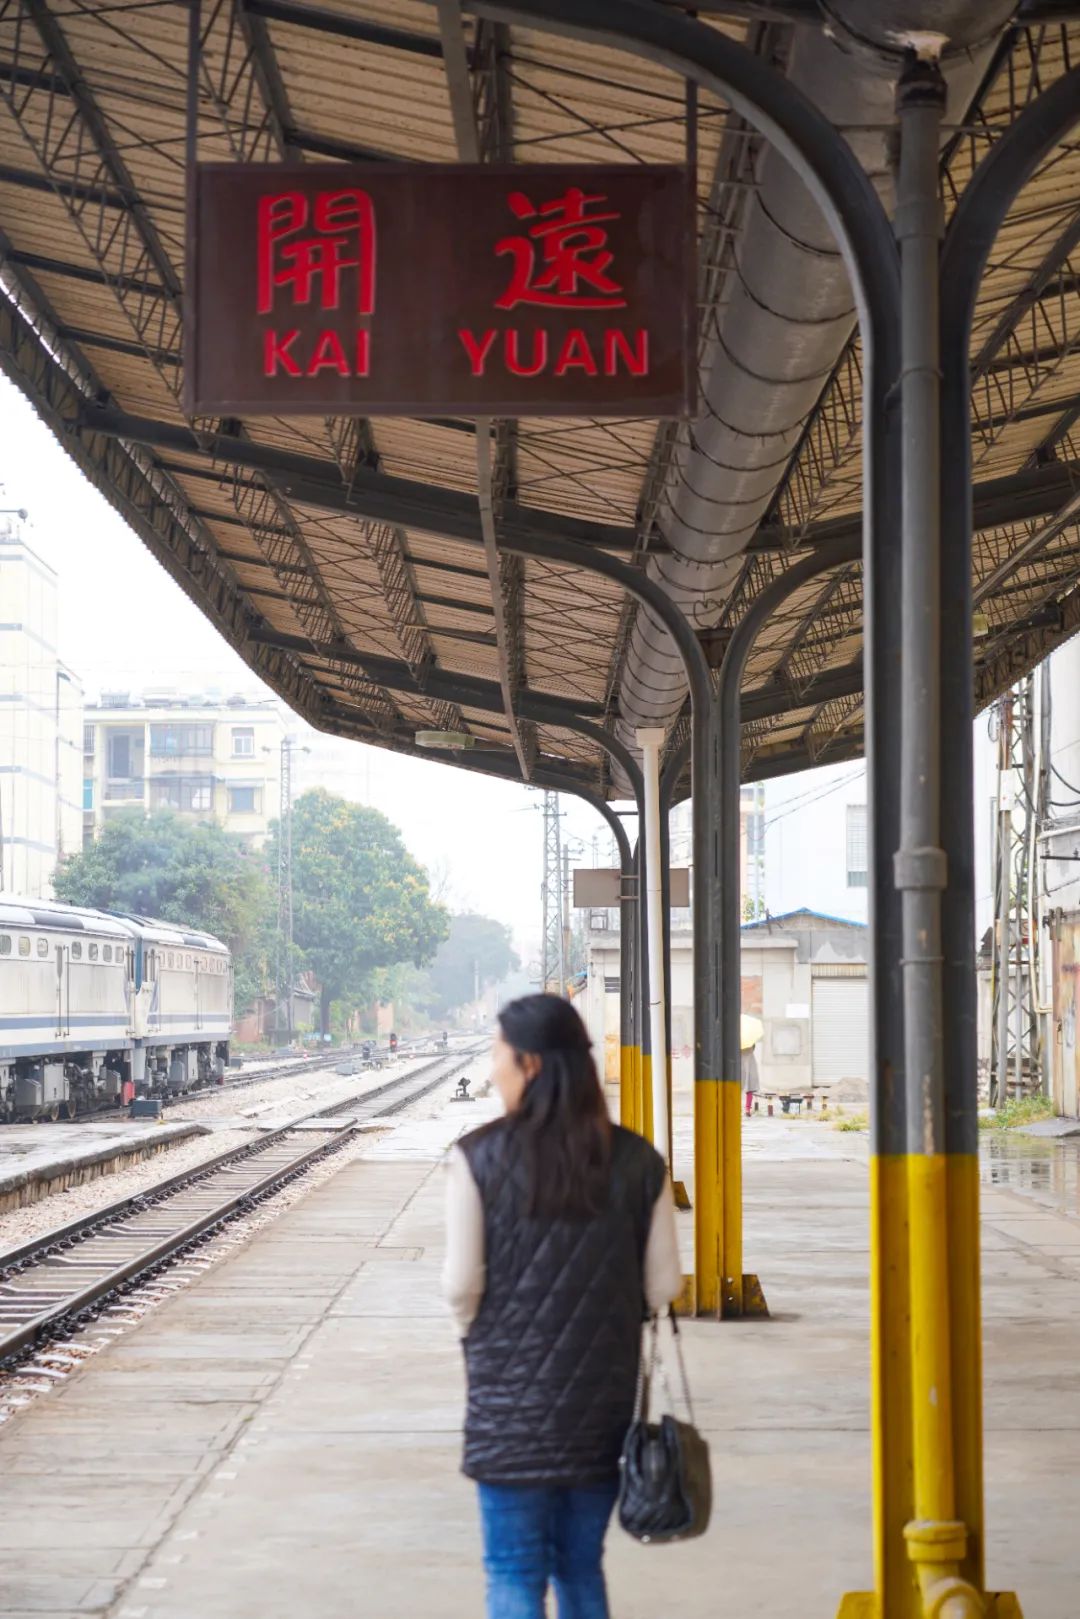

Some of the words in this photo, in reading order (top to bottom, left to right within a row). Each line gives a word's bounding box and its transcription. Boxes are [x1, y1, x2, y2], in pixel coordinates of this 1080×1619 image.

[257, 189, 627, 314] 開遠
[264, 328, 370, 377] KAI
[458, 328, 650, 377] YUAN
